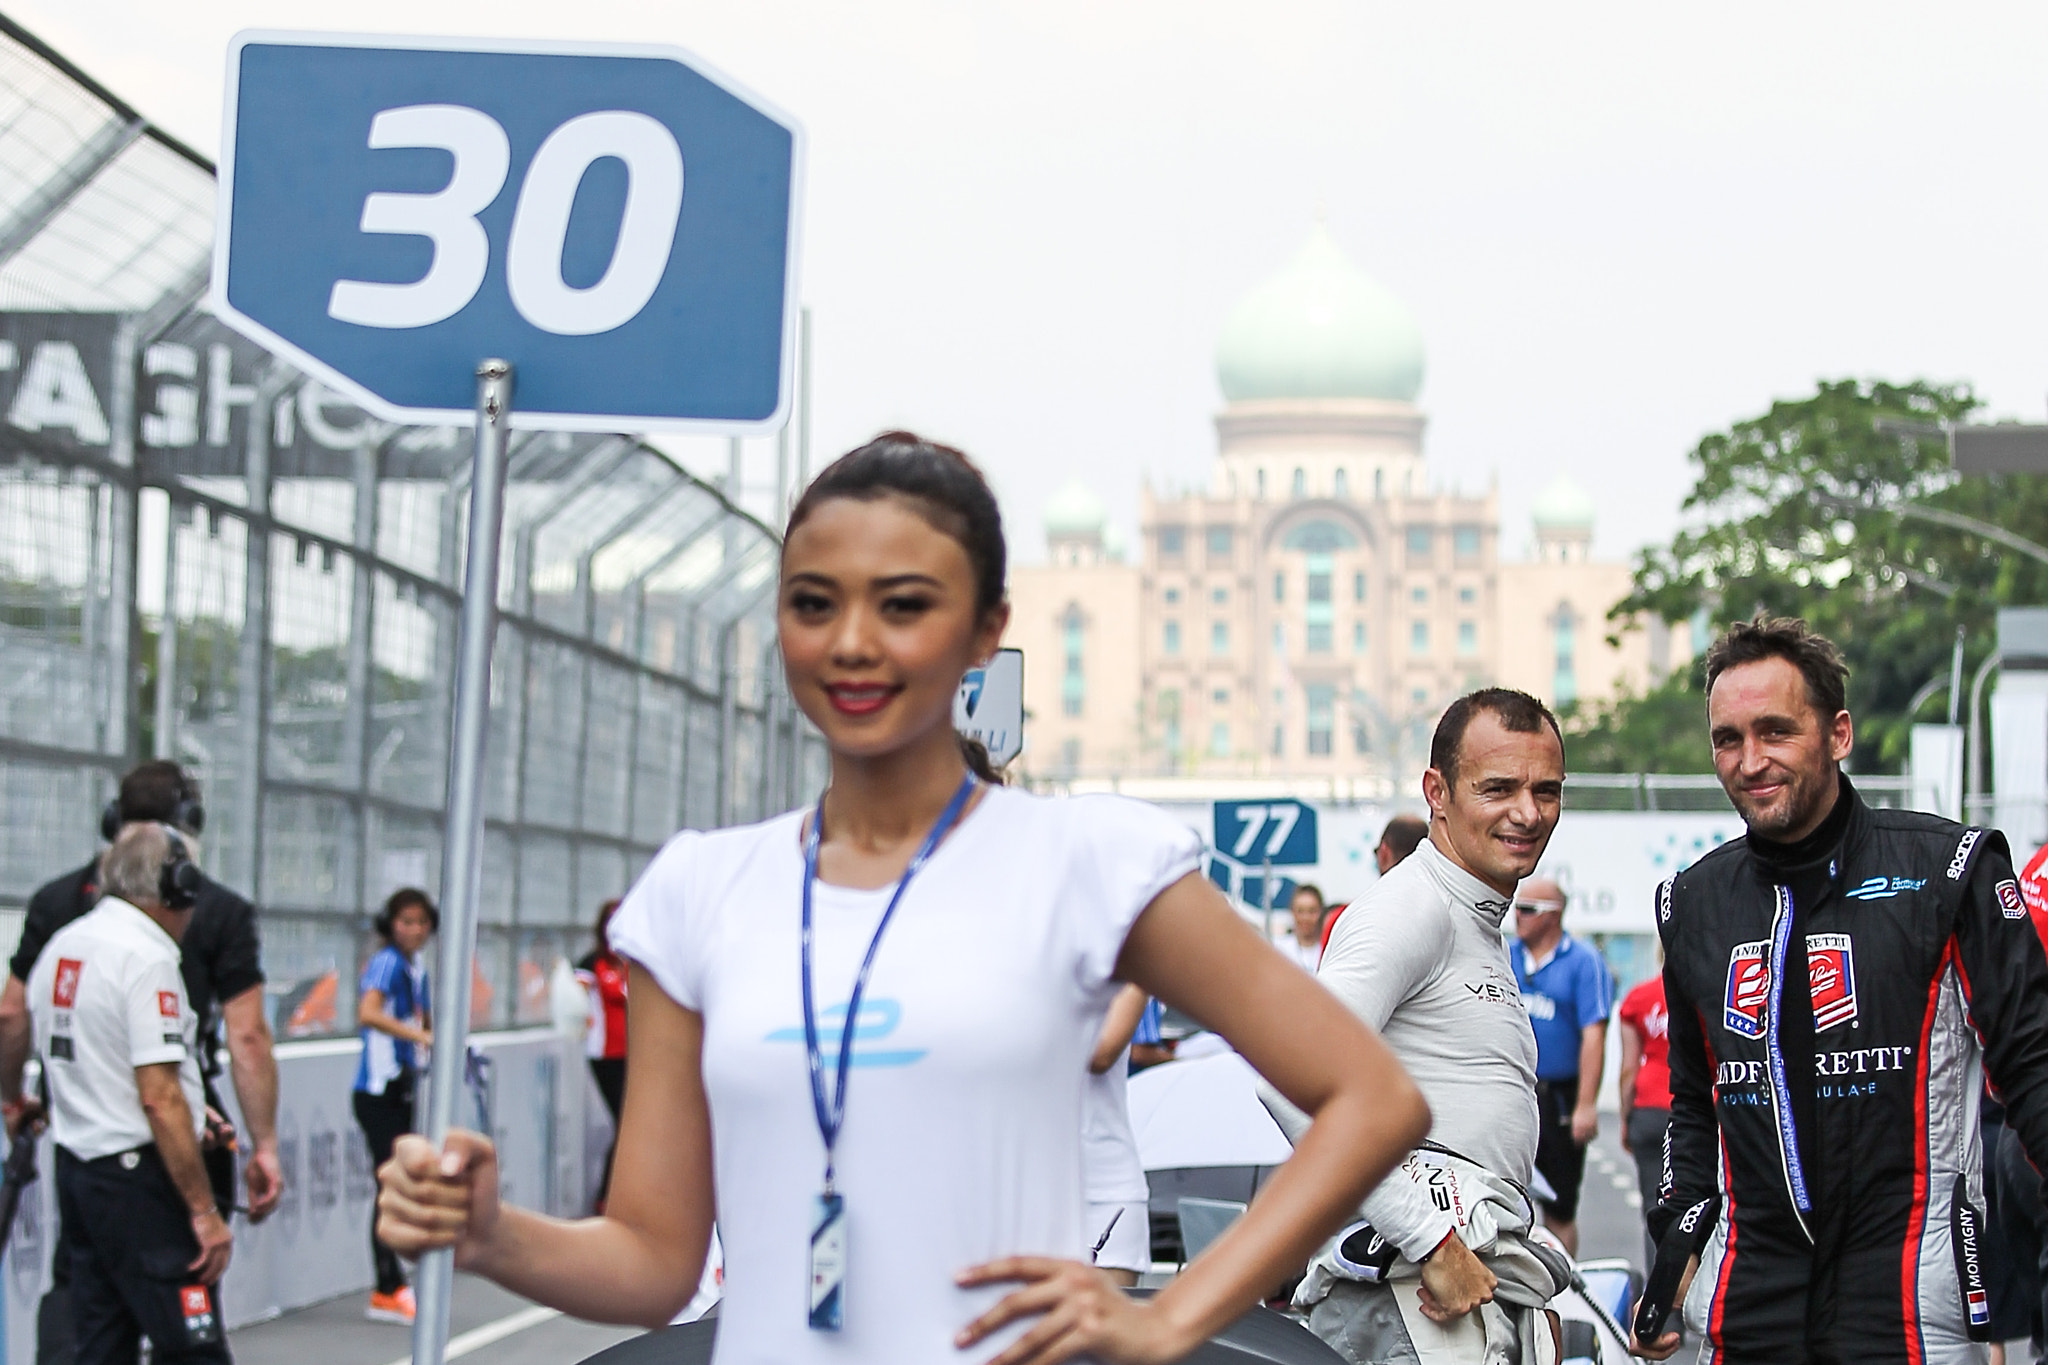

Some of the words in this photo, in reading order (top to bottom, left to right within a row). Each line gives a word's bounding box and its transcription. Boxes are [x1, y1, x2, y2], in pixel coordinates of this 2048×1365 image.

[327, 103, 685, 336] 30
[1233, 804, 1301, 857] 77
[1661, 871, 1678, 924] parco
[1959, 1207, 1982, 1288] MONTAGNY
